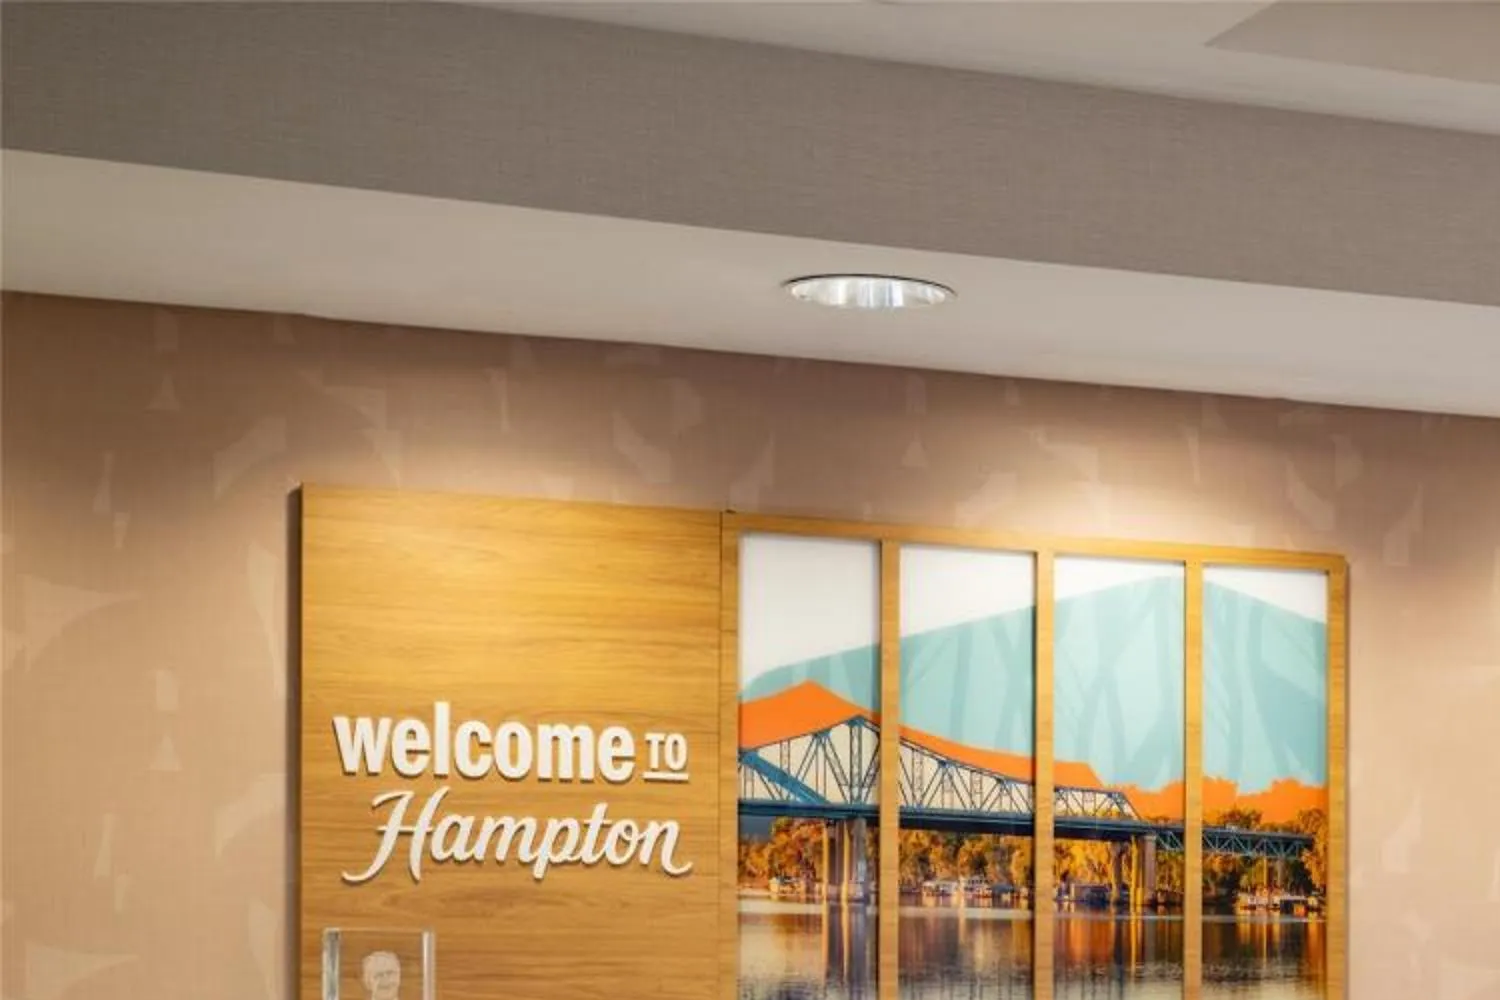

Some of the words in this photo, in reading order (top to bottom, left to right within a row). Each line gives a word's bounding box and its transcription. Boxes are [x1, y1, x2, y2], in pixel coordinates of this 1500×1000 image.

[332, 700, 637, 784] welcome
[643, 731, 690, 782] TO
[340, 785, 693, 884] Hampton
